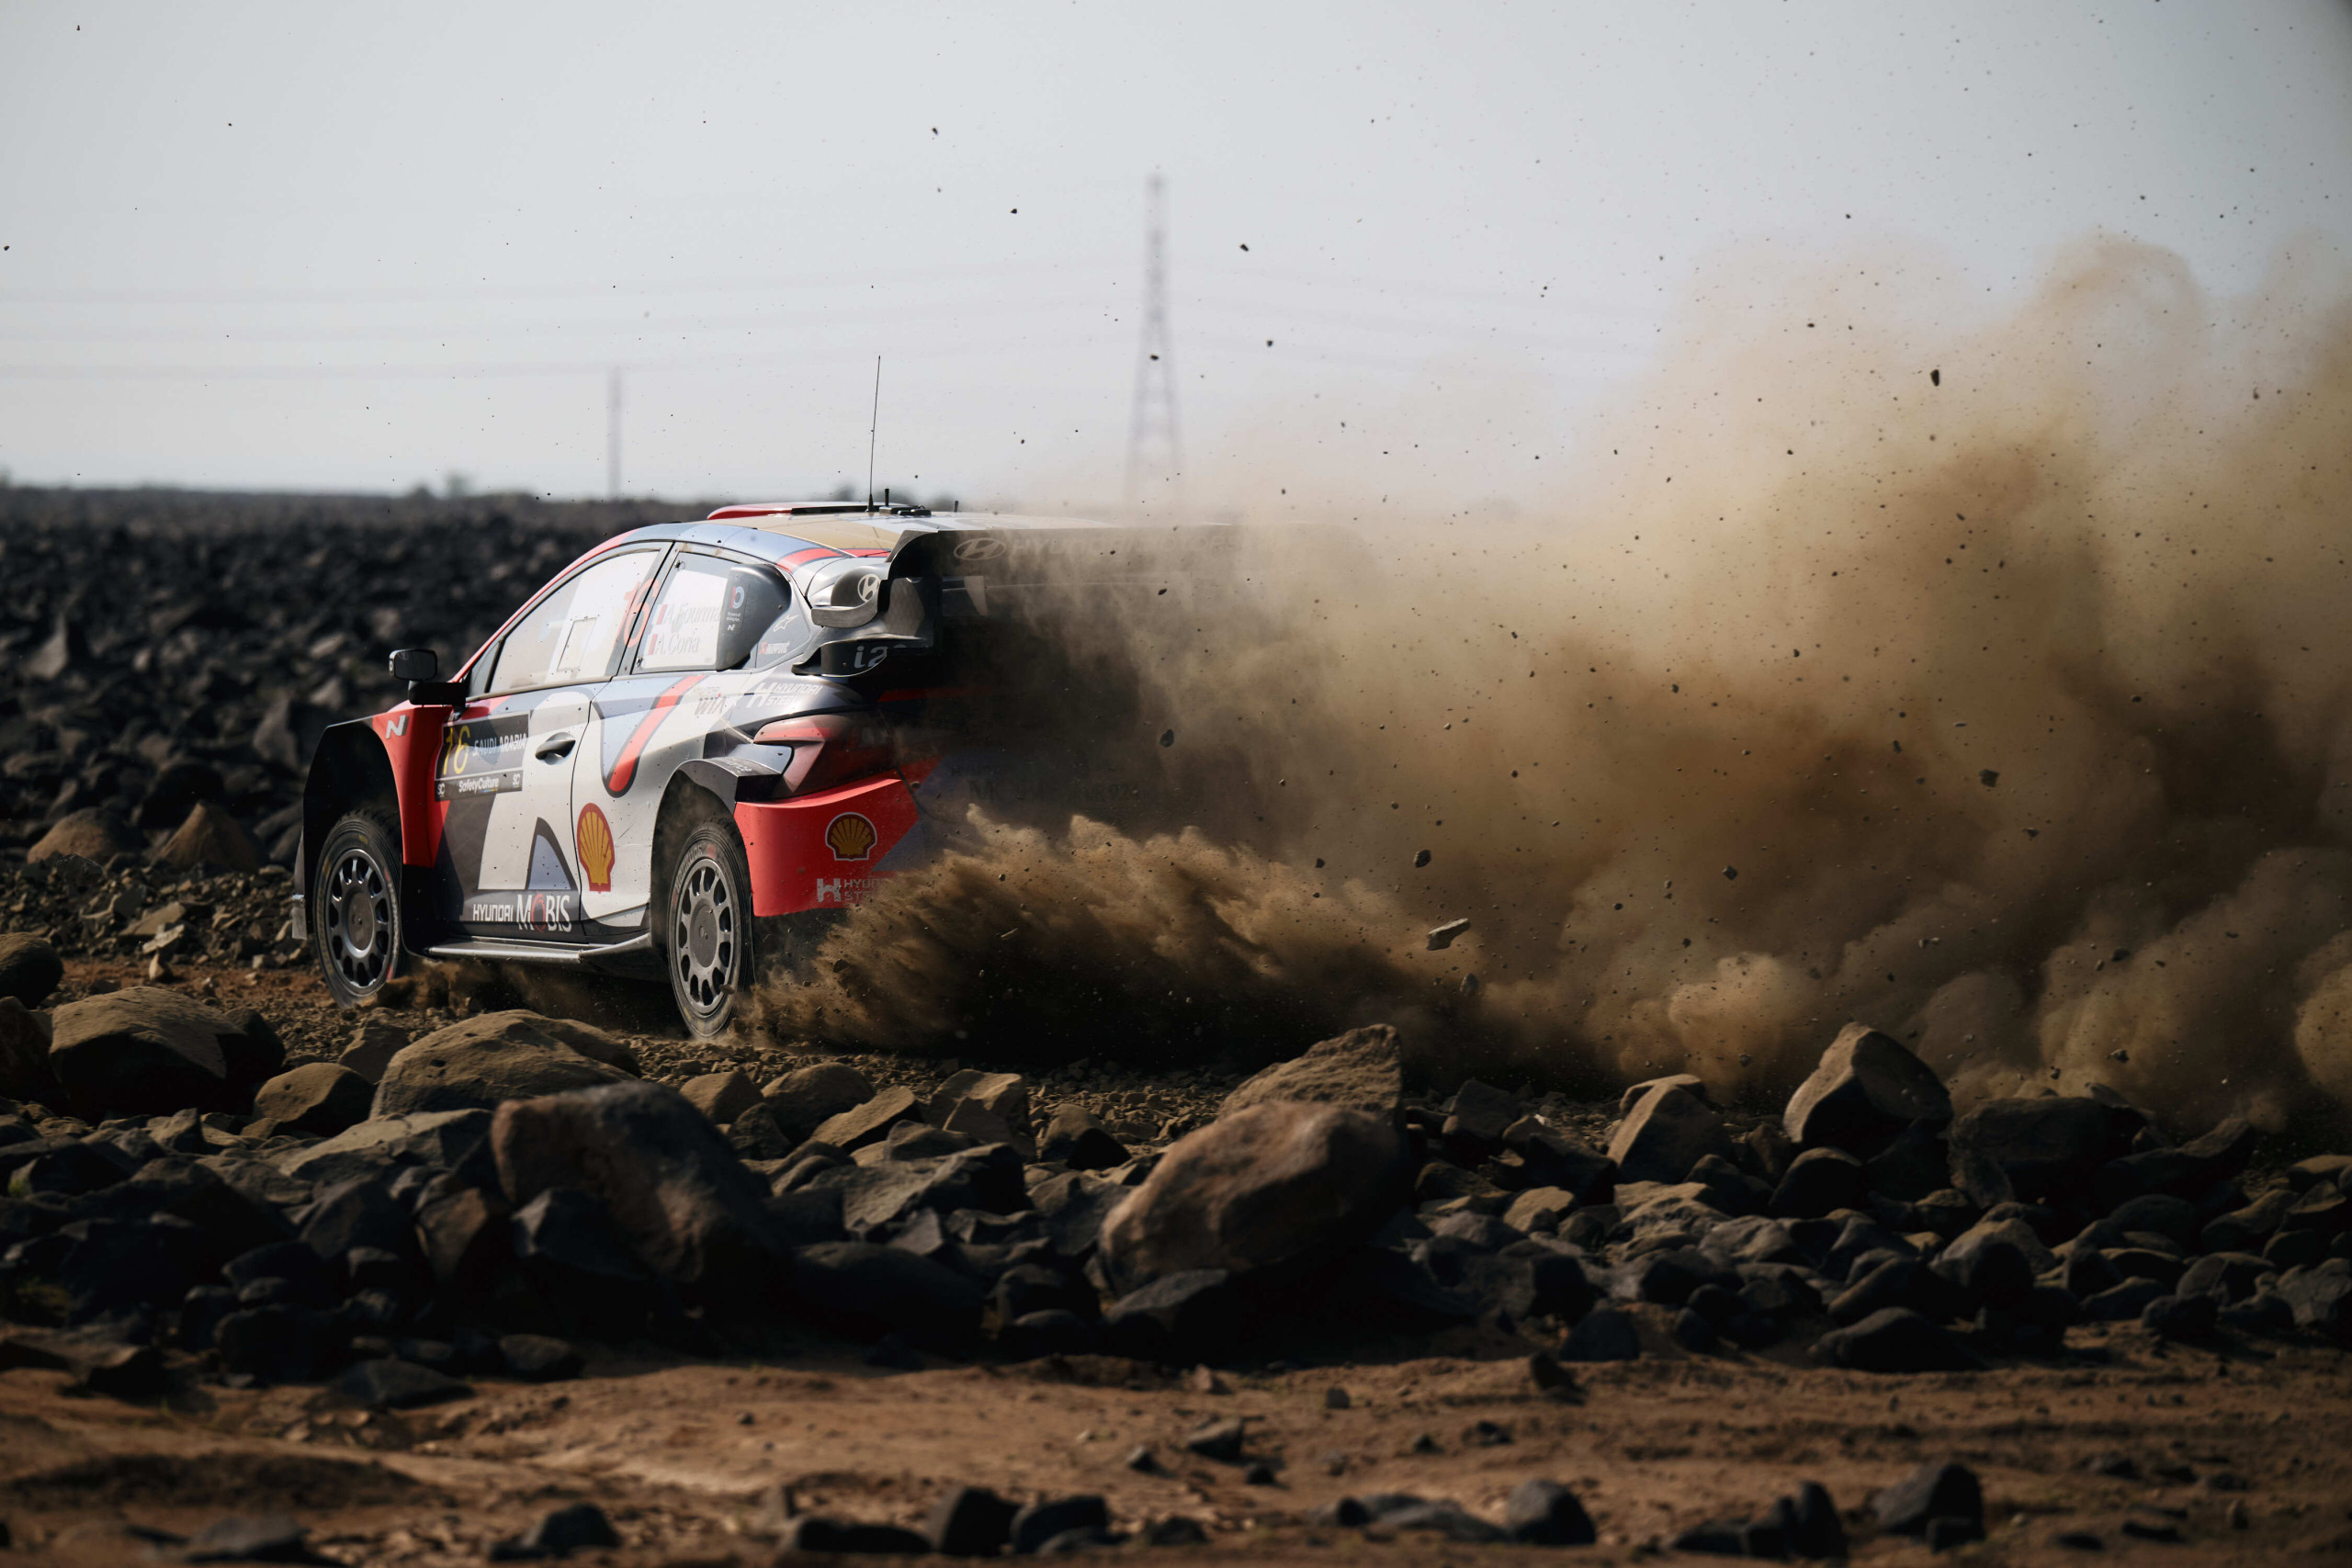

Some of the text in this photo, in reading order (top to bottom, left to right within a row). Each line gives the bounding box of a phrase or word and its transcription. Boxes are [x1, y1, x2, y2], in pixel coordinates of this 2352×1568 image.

[775, 682, 823, 696] HYUNDAI
[385, 714, 407, 739] N
[443, 725, 471, 776] 16
[472, 733, 527, 757] SAUDI ARABIA
[458, 776, 500, 795] SafetyCulture
[472, 893, 572, 933] HYUNDAI MOBIS
